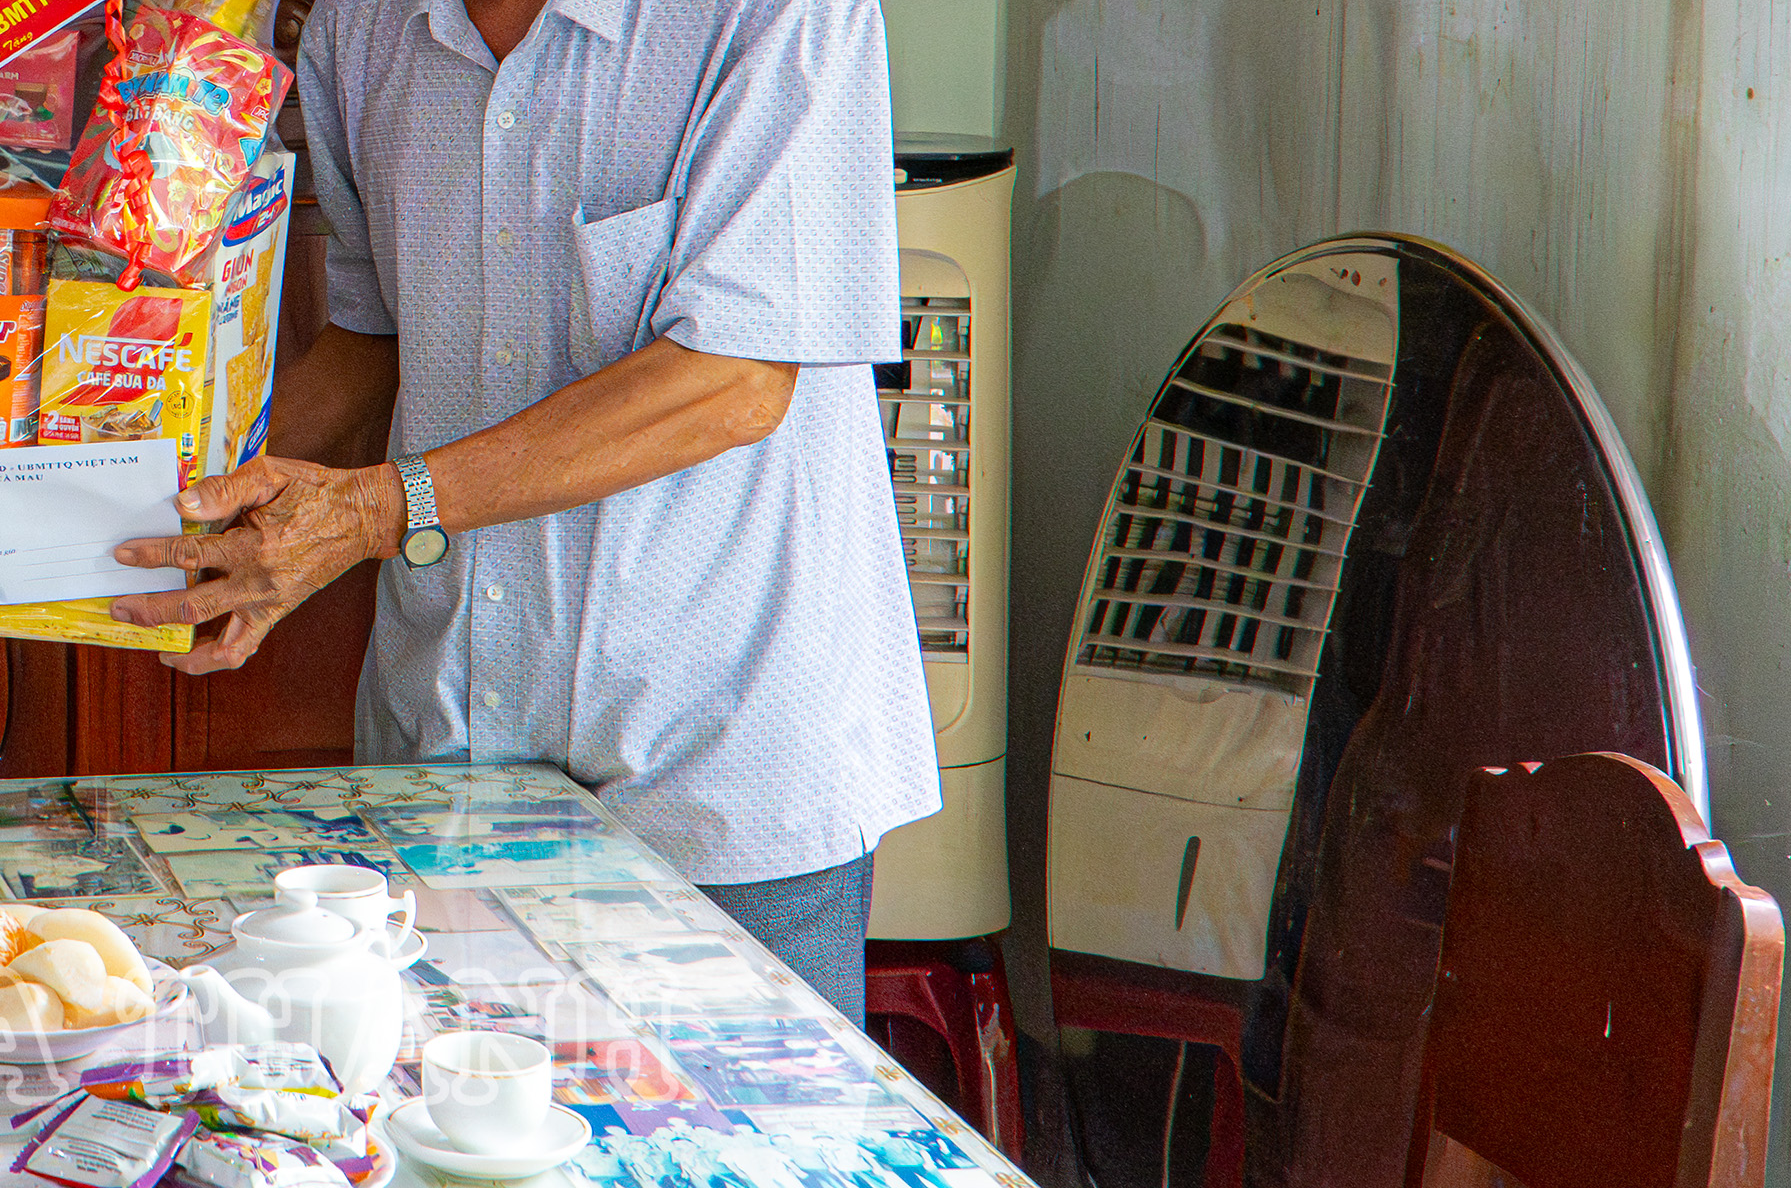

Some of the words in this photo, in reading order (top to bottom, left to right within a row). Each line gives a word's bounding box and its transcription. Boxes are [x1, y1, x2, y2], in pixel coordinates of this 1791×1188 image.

[235, 178, 284, 219] Magic
[110, 455, 140, 465] NAM
[15, 473, 44, 482] MAU
